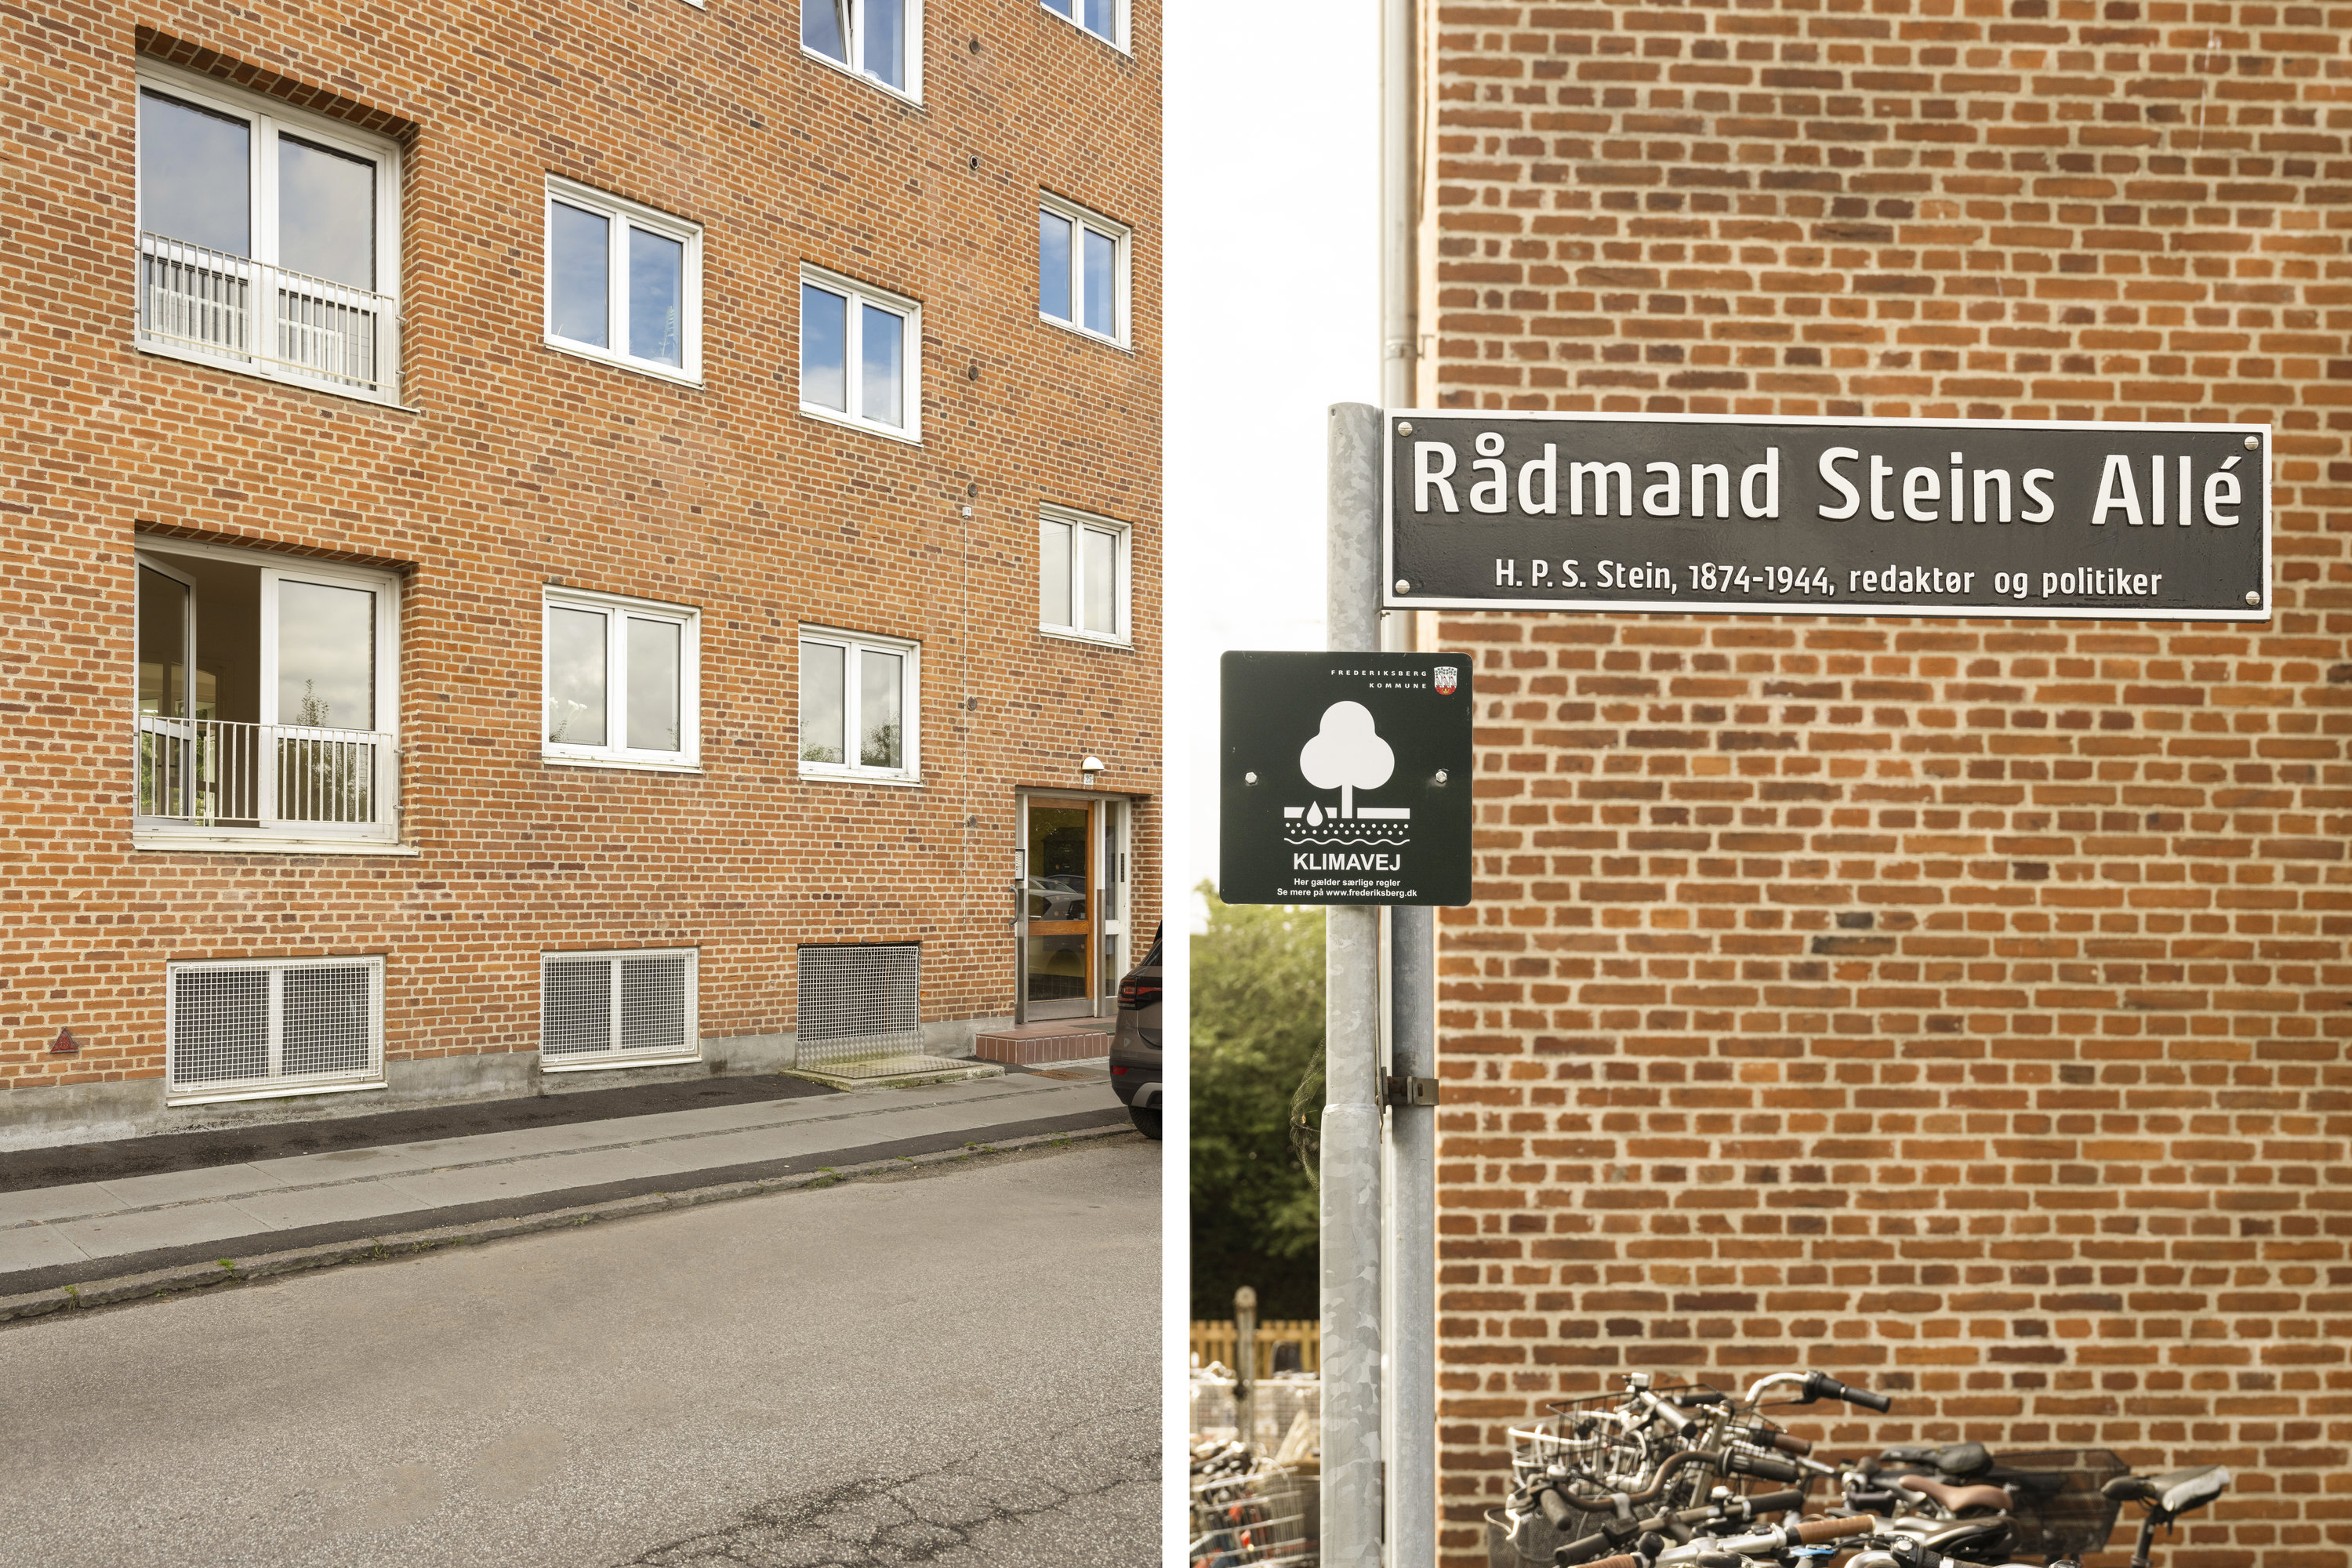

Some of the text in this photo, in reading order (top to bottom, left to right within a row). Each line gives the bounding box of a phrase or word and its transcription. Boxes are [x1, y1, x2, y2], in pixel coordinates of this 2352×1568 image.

[1414, 431, 2243, 526] Rådmand Steins Allé
[1495, 558, 2162, 599] H. P. S. Stein, 1874-1944, redaktør og politiker
[1294, 852, 1401, 871] KLIMAVEJ
[1294, 877, 1401, 887] Her gælder særlige regler
[1313, 887, 1323, 897] på
[1326, 888, 1417, 898] www.frederiksberg.dk
